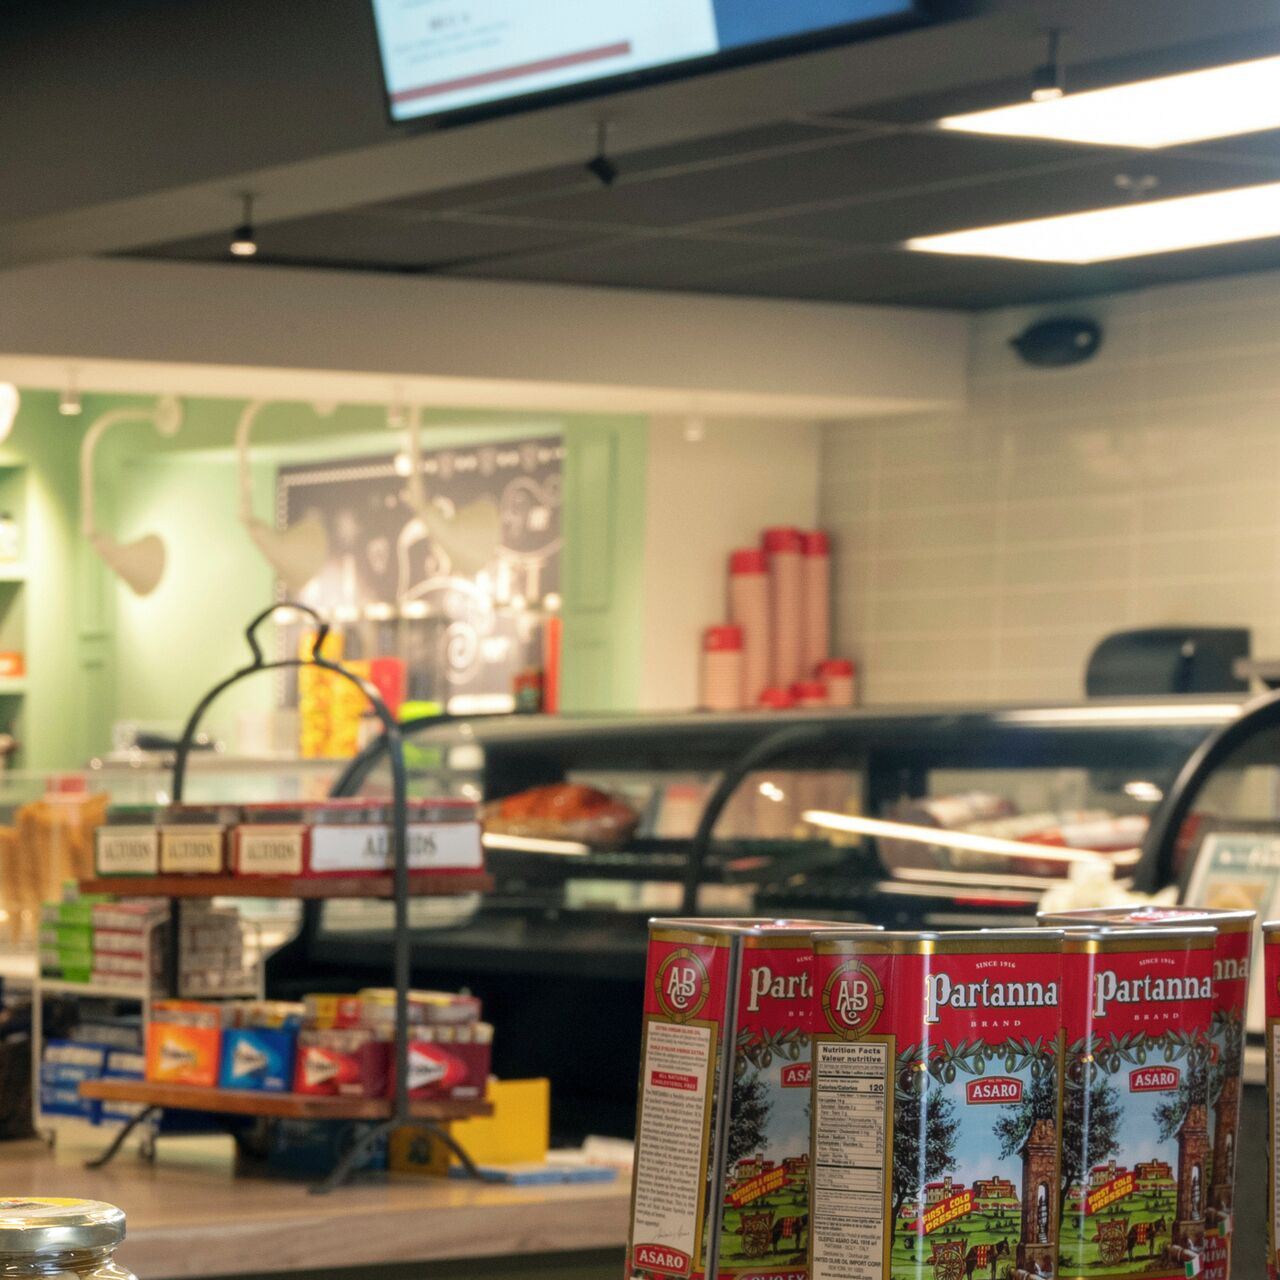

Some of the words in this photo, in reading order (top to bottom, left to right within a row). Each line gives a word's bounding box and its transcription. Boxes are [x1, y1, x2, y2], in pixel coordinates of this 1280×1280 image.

[925, 972, 1058, 1025] Partanna
[1094, 970, 1212, 1018] Partanna
[972, 1084, 1017, 1098] ASARO
[1135, 1073, 1175, 1086] ASARO
[922, 1204, 946, 1224] FIRST
[949, 1192, 971, 1208] COLD
[925, 1203, 972, 1232] PRESSED
[639, 1250, 684, 1269] ASARO
